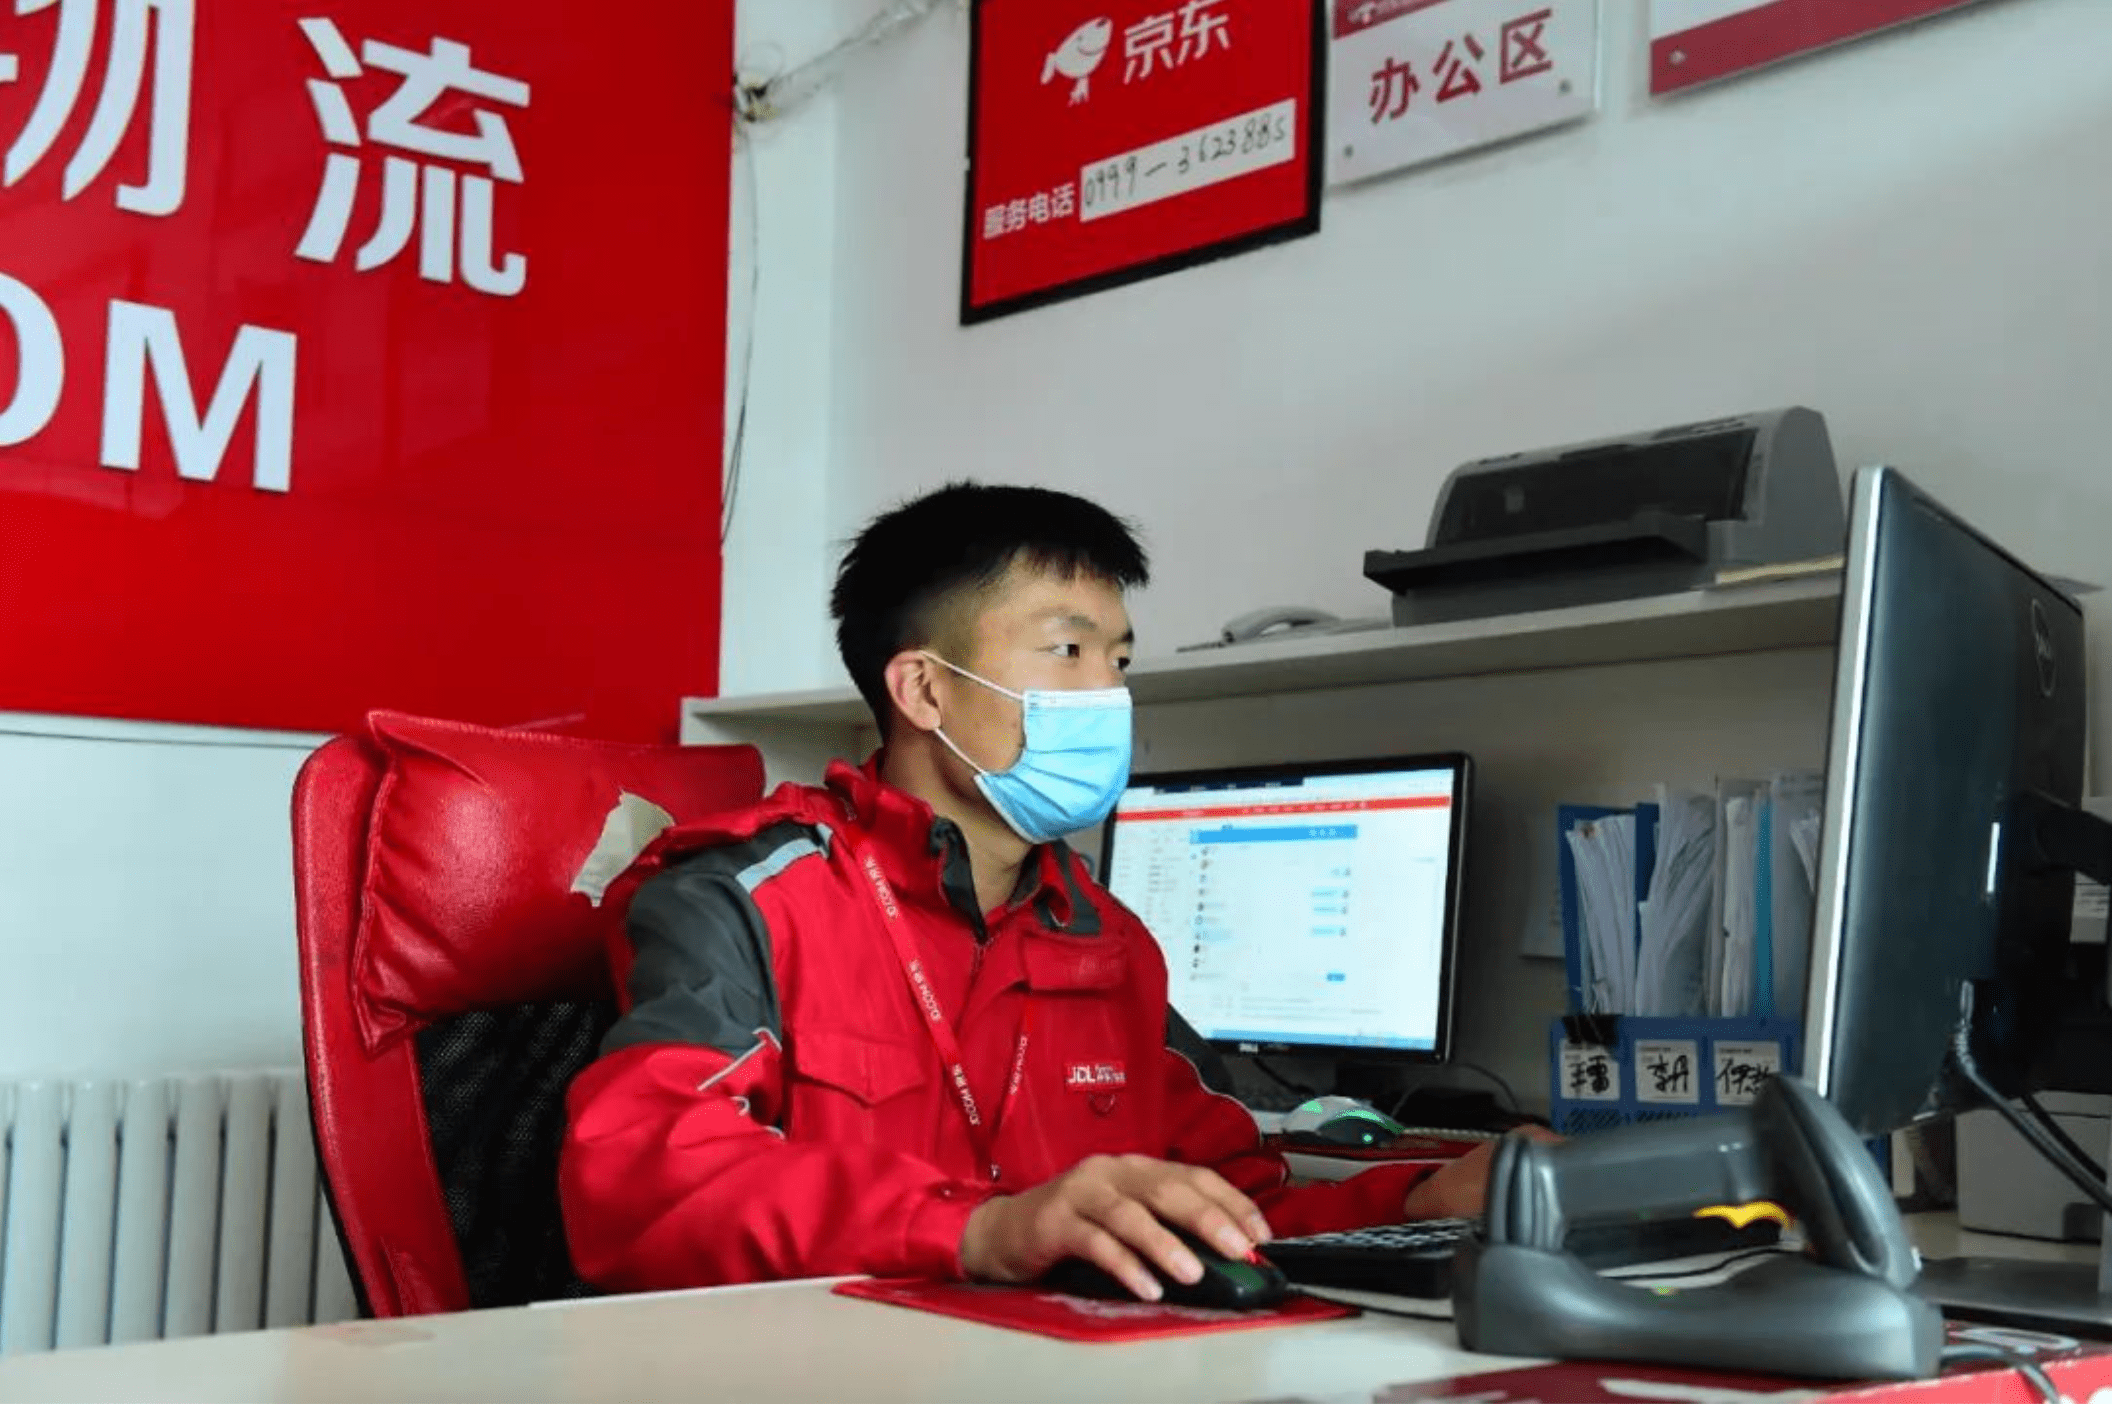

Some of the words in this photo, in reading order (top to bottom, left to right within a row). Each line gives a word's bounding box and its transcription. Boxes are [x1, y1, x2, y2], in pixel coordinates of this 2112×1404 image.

[1123, 0, 1231, 85] 京东
[1369, 8, 1553, 124] 办公区
[983, 181, 1075, 240] 服务电话
[1067, 1065, 1096, 1084] JDL
